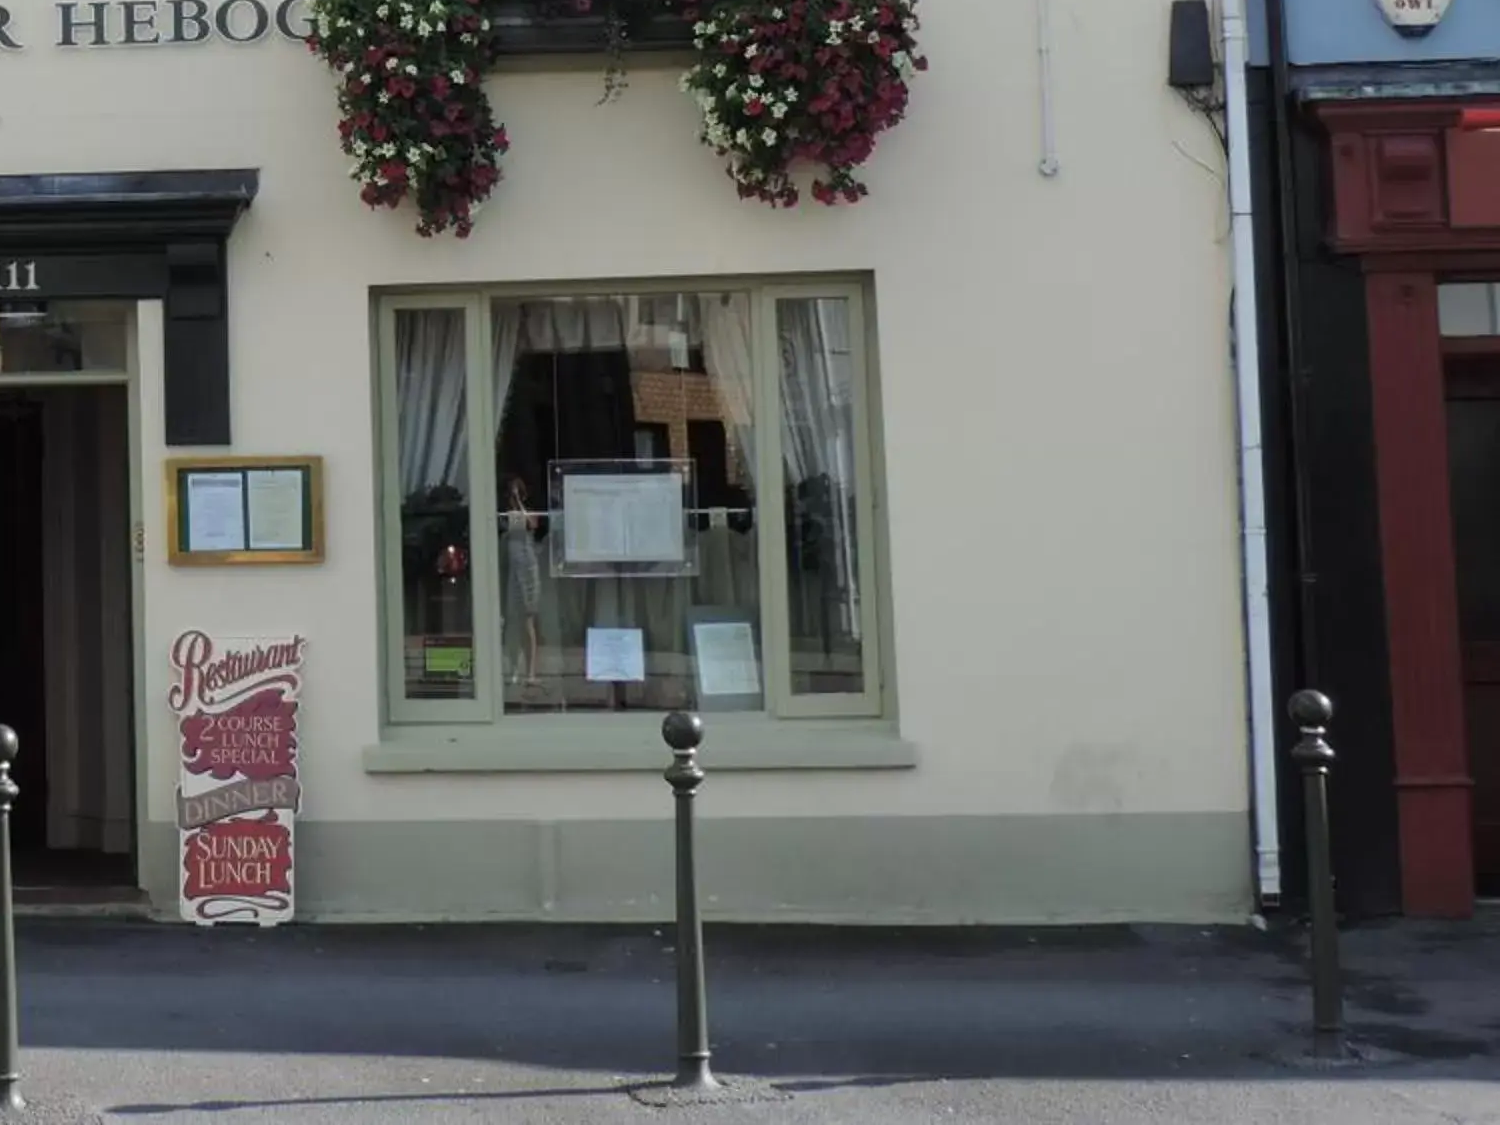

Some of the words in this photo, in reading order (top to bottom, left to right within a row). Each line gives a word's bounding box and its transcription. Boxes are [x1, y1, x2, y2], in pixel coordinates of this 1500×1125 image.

[168, 630, 305, 712] Restaurant
[199, 716, 215, 741] 2
[217, 716, 284, 732] COURSE
[222, 732, 280, 748] LUNCH
[211, 748, 279, 765] SPECIAL
[184, 781, 290, 823] DINNER
[196, 832, 283, 862] SUNDAY
[200, 861, 272, 889] LUNCH
